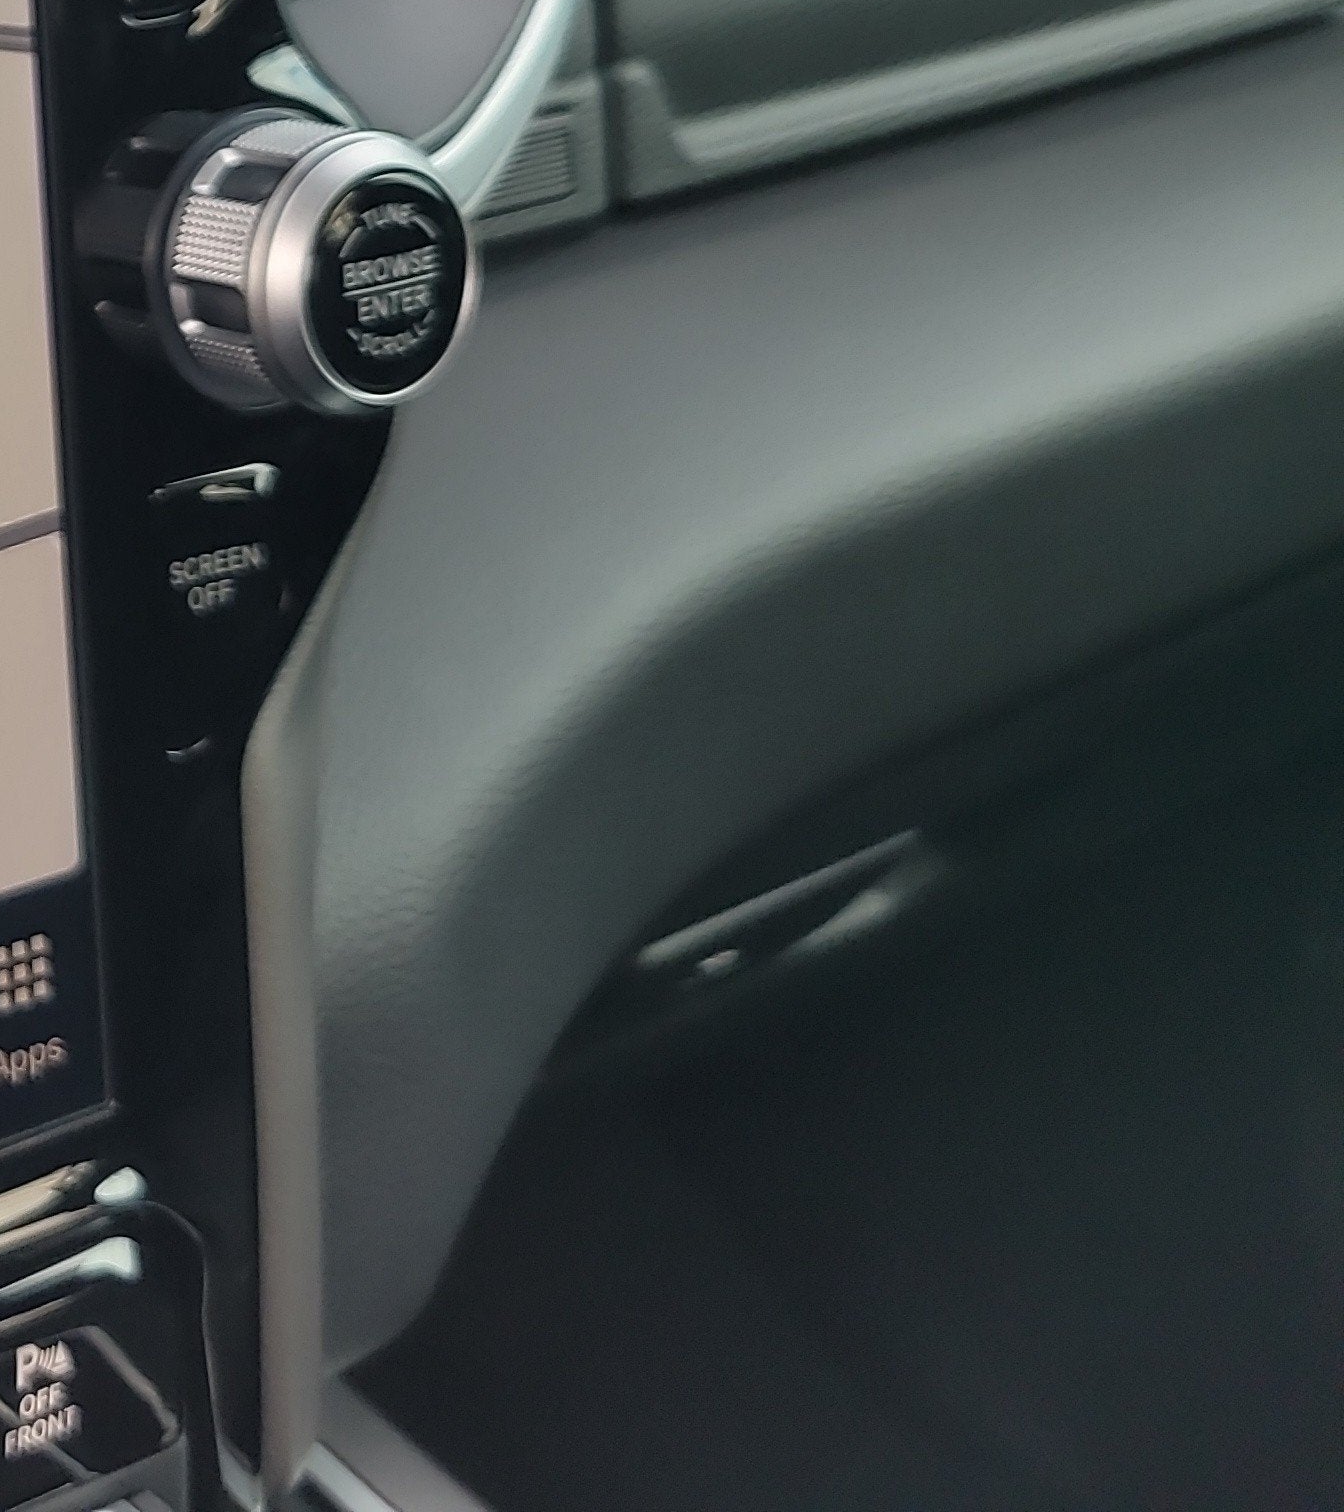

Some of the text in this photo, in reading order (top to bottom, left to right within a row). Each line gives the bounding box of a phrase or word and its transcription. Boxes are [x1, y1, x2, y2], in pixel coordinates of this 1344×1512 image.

[341, 245, 443, 289] BROWSE
[357, 285, 433, 323] ENTER
[168, 542, 265, 588] SCREEN
[187, 577, 238, 613] OFF
[18, 1383, 69, 1418] OFF
[4, 1405, 83, 1459] FRONT
